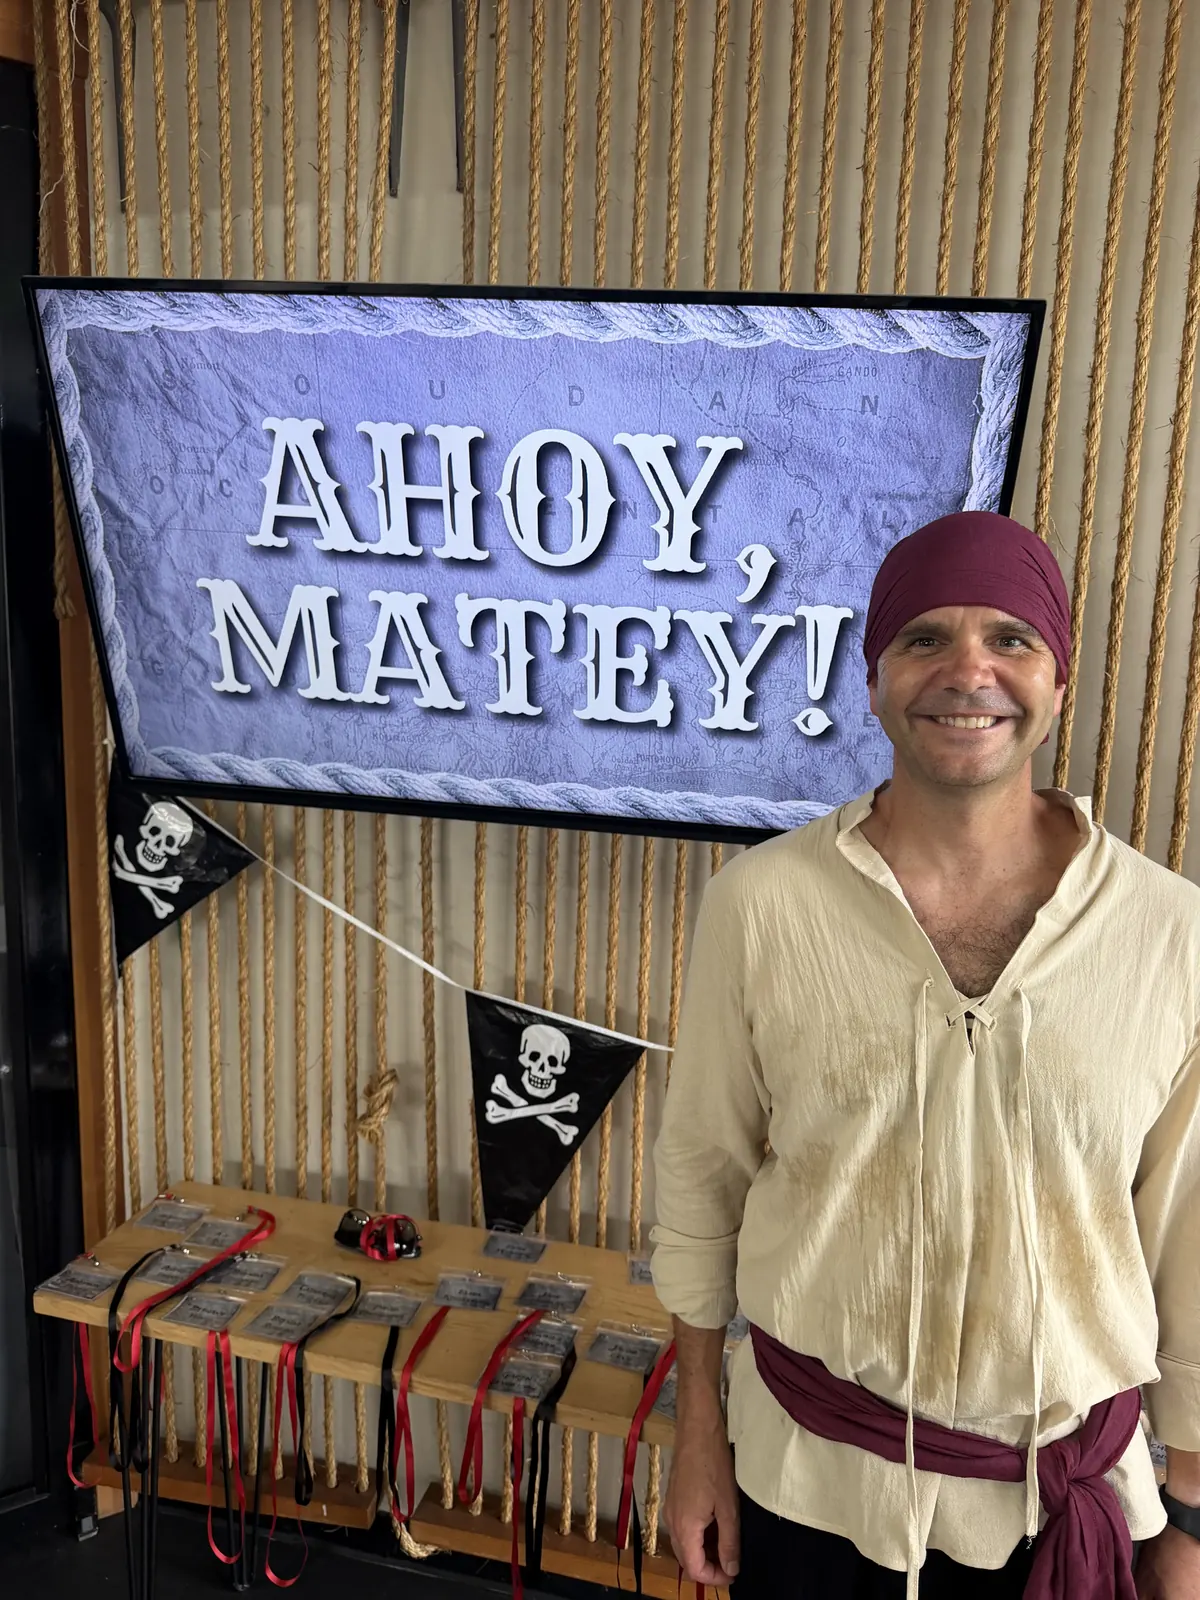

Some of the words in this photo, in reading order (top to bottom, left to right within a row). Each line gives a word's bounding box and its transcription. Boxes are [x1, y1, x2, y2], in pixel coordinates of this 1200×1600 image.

[837, 365, 878, 378] GANDO
[246, 417, 777, 603] AHOY,
[195, 577, 854, 737] MATEY!
